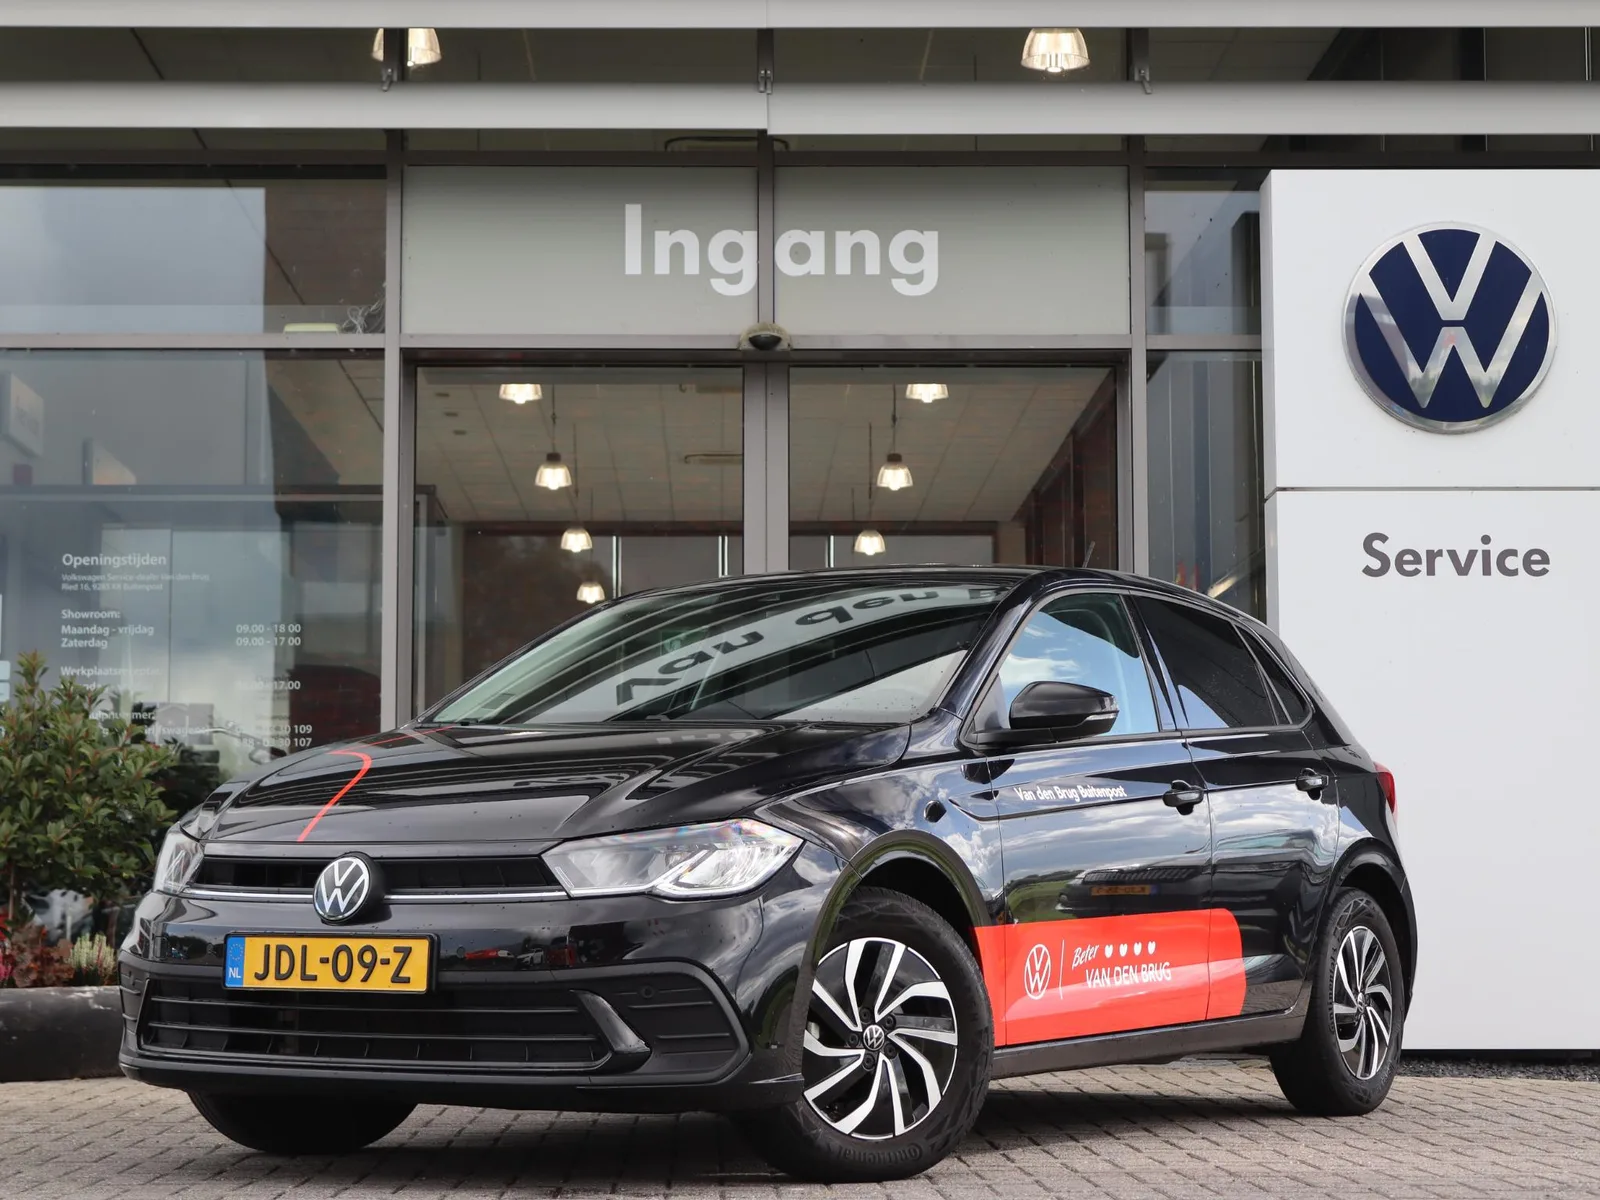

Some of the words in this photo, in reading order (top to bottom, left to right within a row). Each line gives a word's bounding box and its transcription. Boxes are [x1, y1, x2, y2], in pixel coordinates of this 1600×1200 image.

[625, 204, 939, 296] Ingang
[62, 553, 167, 568] Openingstijden
[1361, 532, 1551, 578] Service
[61, 609, 121, 619] Showroom:
[61, 624, 109, 637] Maandag
[118, 624, 154, 637] vrijdag
[236, 623, 265, 633] 09.00
[61, 637, 108, 650] Zaterdag
[236, 637, 265, 646] 09.00
[273, 680, 301, 690] 17.00
[294, 724, 313, 734] 109
[294, 737, 312, 747] 107
[1014, 786, 1036, 801] Van
[1037, 785, 1055, 800] den
[1054, 785, 1079, 803] Brug
[1077, 784, 1127, 801] Buitenpost
[254, 943, 413, 983] JDL-09-Z
[1072, 944, 1100, 970] Beter
[228, 966, 241, 979] NL
[1085, 967, 1111, 988] VAN
[1113, 965, 1138, 986] DEN
[1140, 962, 1172, 983] BRUG
